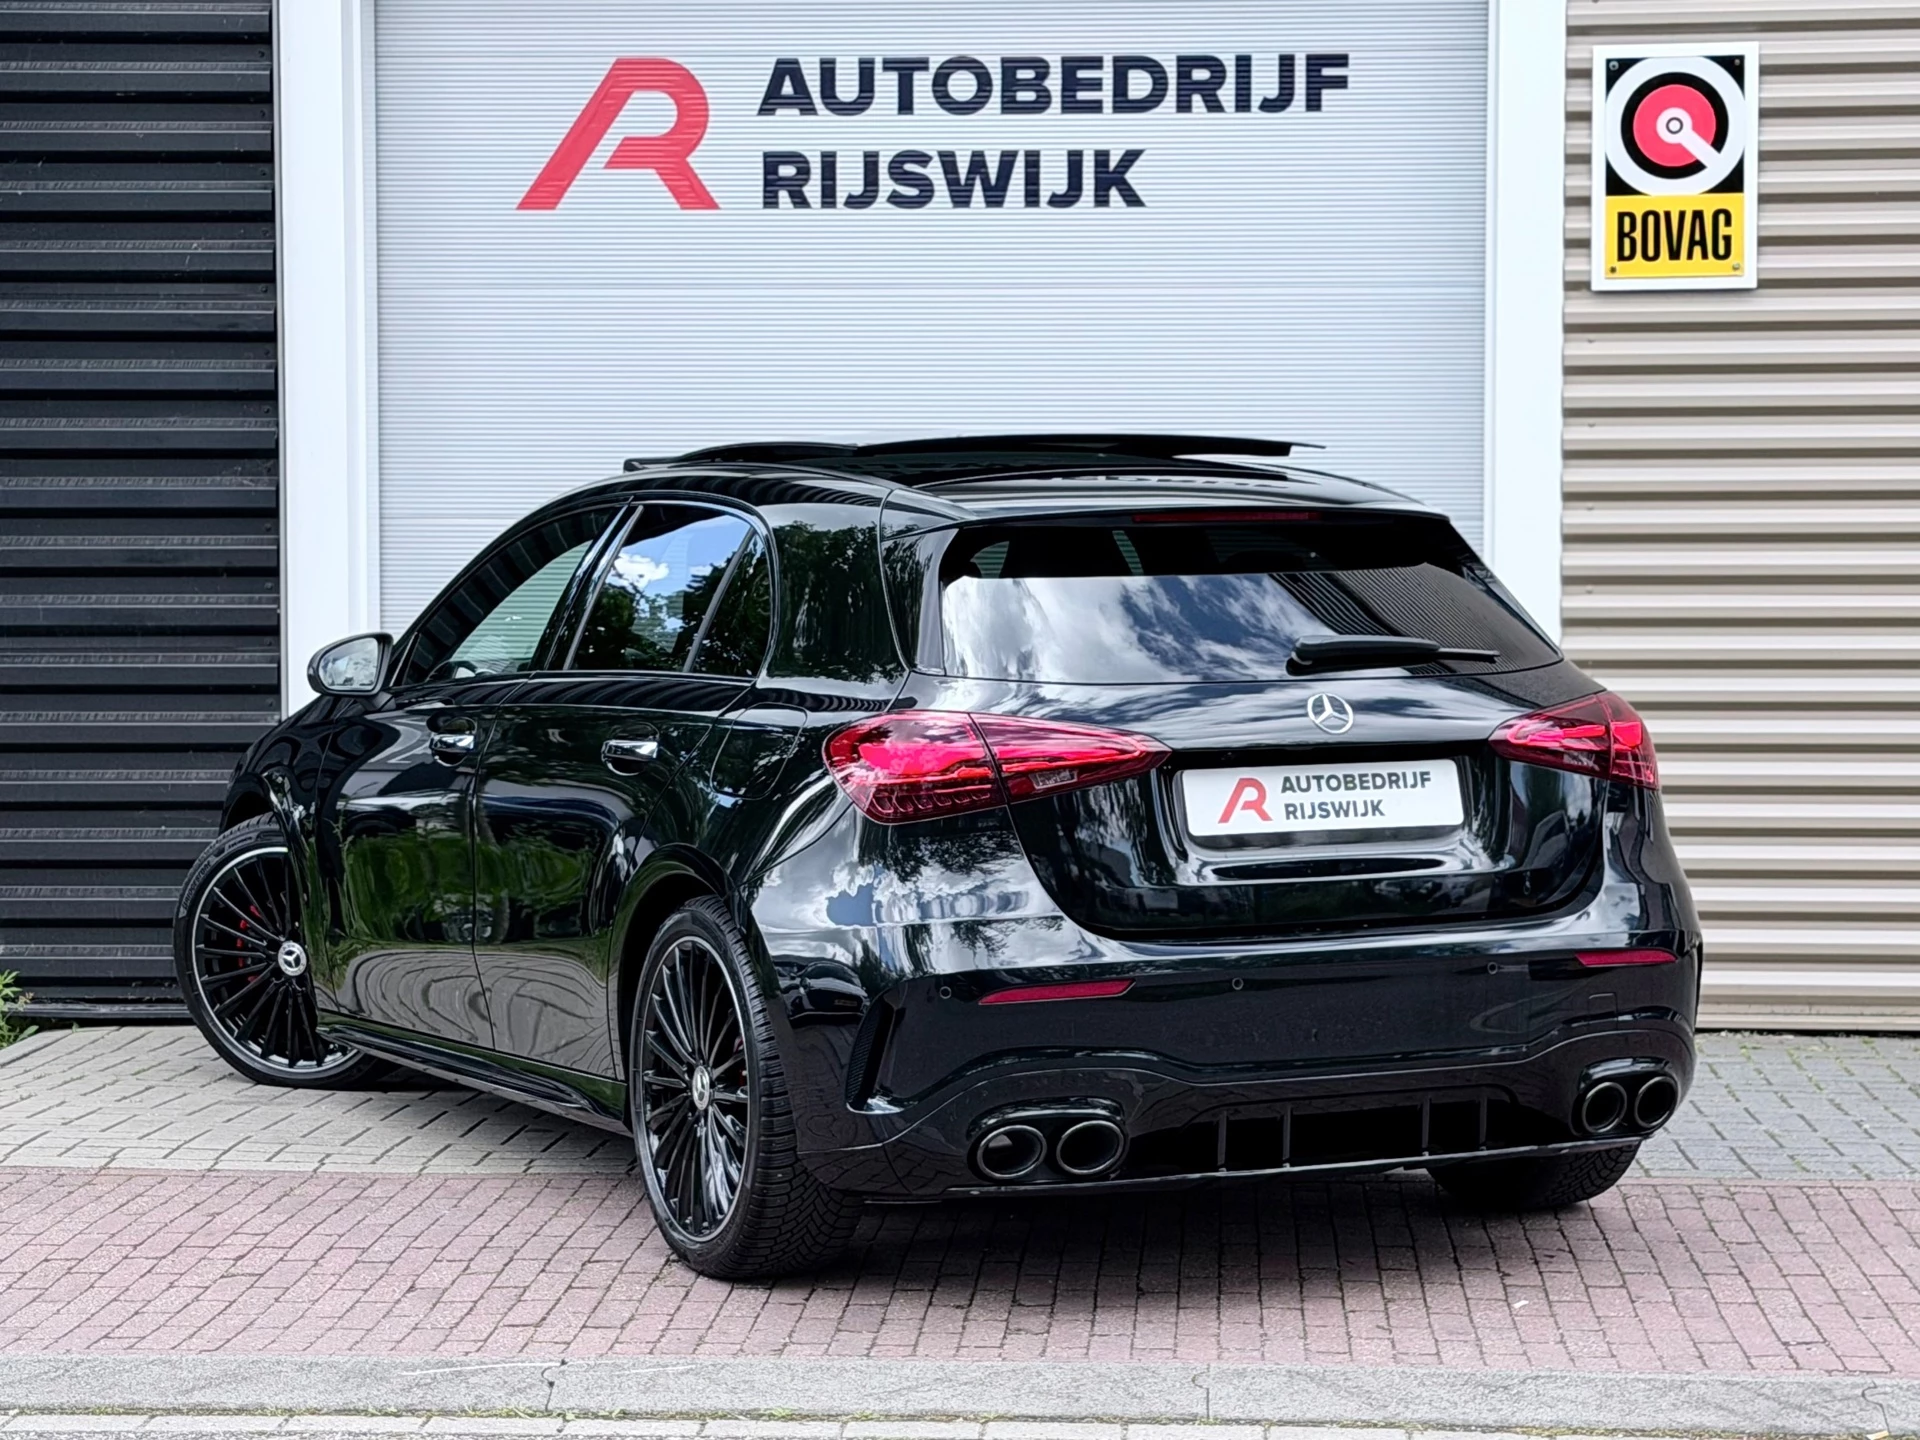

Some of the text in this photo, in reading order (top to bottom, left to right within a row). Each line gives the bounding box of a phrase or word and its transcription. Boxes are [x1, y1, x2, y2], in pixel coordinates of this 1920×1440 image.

[757, 53, 1350, 116] AUTOBEDRIJF
[761, 149, 1147, 210] RIJSWIJK
[1616, 208, 1733, 263] BOVAG
[1280, 770, 1432, 794] AUTOBEDRIJF
[1283, 799, 1386, 821] RIJSWIJK
